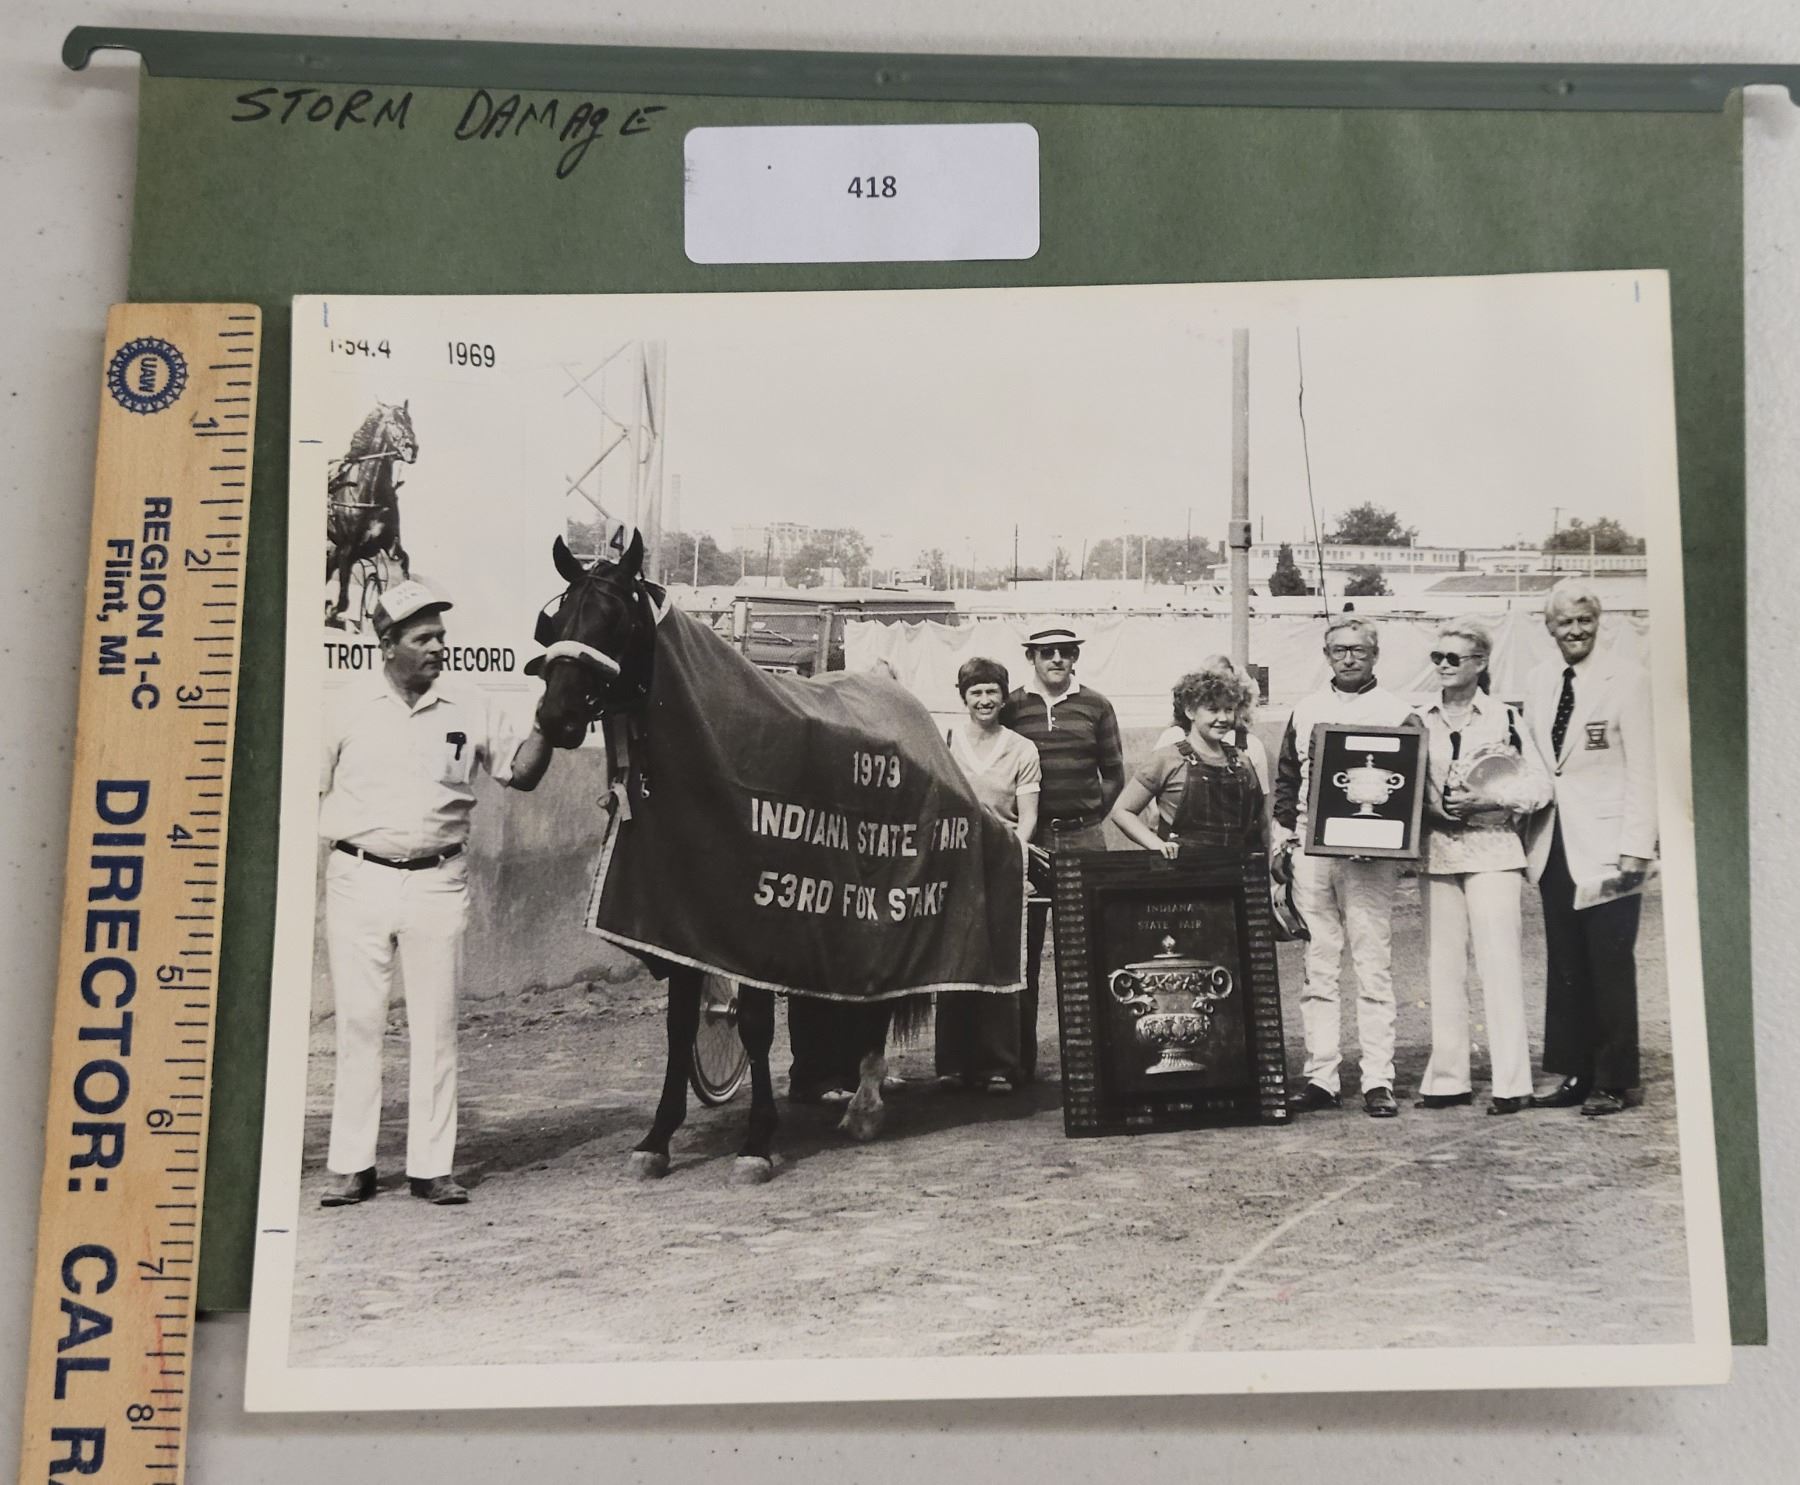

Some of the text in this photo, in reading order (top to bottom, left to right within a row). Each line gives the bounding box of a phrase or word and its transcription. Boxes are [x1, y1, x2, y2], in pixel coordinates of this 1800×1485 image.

[231, 87, 414, 131] STORM
[847, 176, 898, 199] 418
[448, 341, 496, 368] 1969
[139, 357, 158, 392] UAW
[192, 416, 220, 430] 1
[184, 549, 212, 567] 2
[95, 538, 135, 677] Flint, MI
[131, 497, 172, 711] REGION 1-C
[440, 646, 516, 672] RECORD
[176, 685, 203, 702] 3
[853, 751, 901, 788] 1979
[166, 824, 192, 843] 4
[751, 798, 849, 851] INDIANA
[857, 821, 918, 857] STATE
[753, 871, 834, 914] 53RD
[843, 884, 879, 921] FOX
[1146, 903, 1194, 912] INDIANA
[68, 779, 151, 1193] DIRECTOR:
[157, 964, 184, 983] 5
[146, 1109, 173, 1128] 6
[137, 1257, 165, 1275] 7
[48, 1244, 119, 1485] CAL R
[126, 1404, 154, 1422] 8
